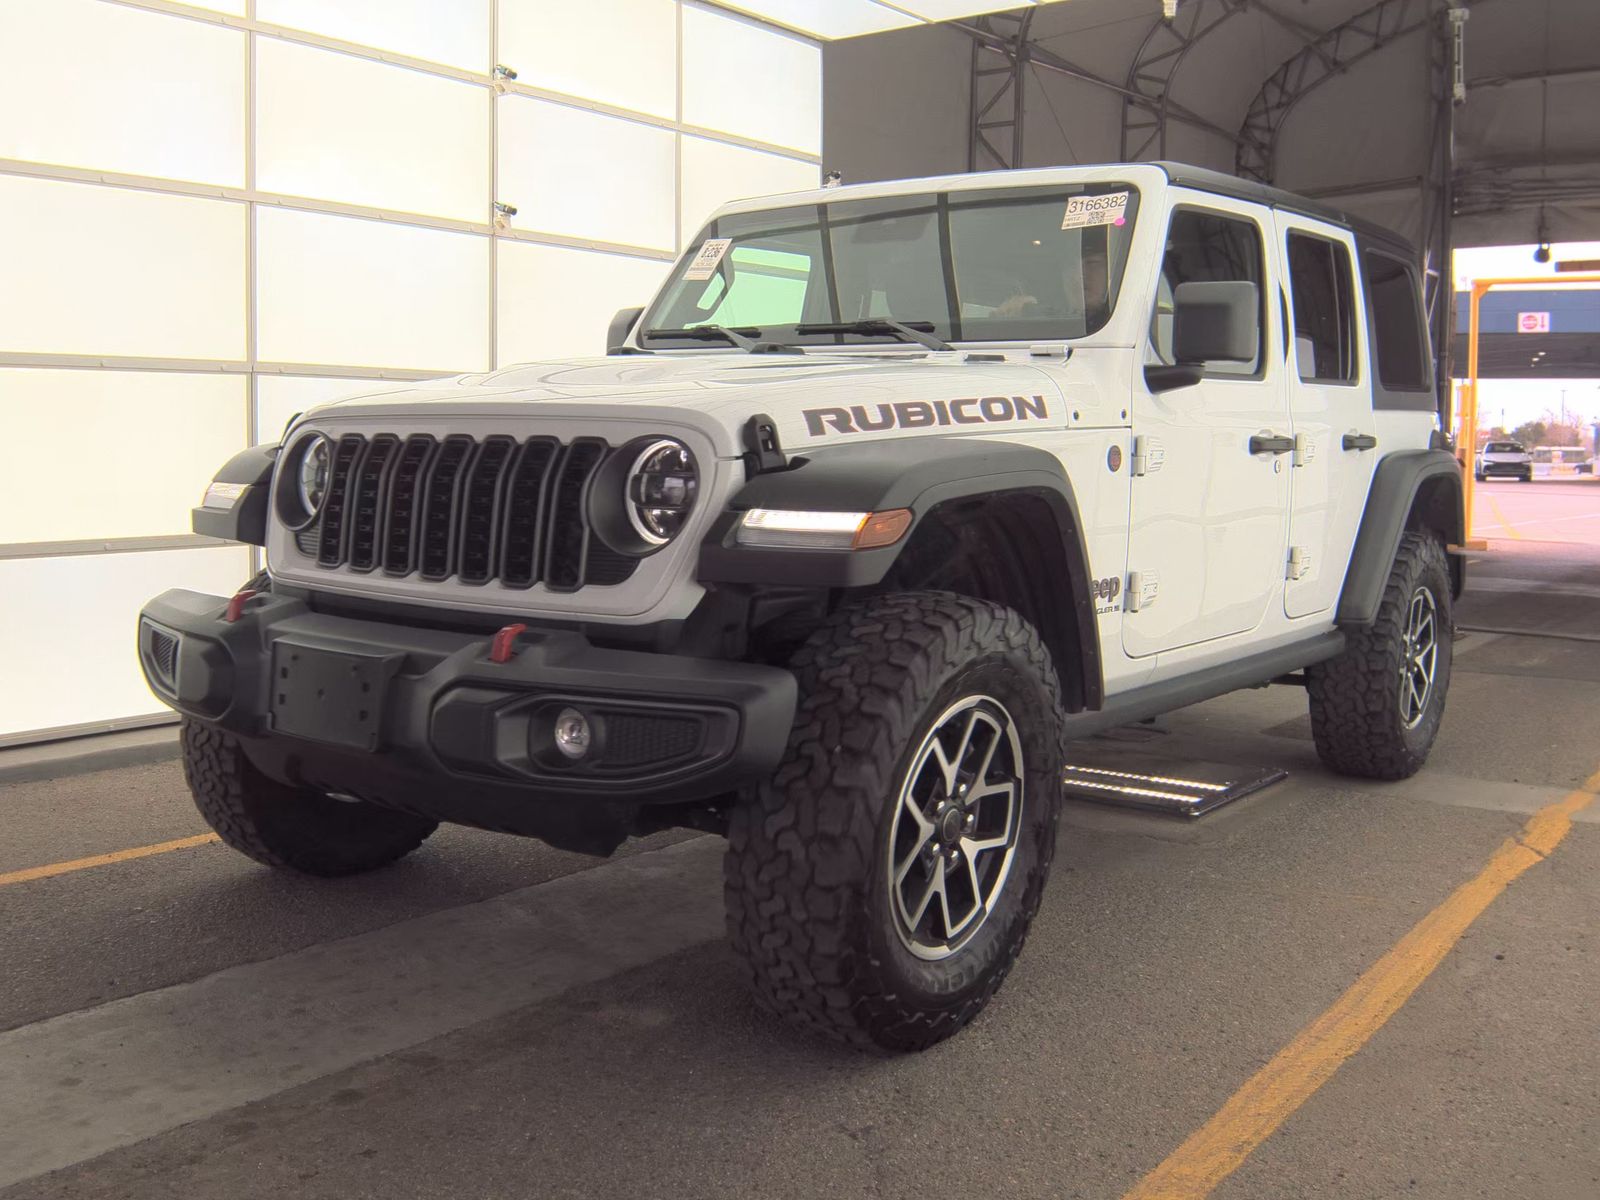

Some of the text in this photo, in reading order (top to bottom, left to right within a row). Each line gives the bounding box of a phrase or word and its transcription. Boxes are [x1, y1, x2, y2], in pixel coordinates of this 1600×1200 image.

[1069, 195, 1127, 213] 3166382
[802, 395, 1048, 436] RUBICON
[1091, 577, 1120, 602] eep
